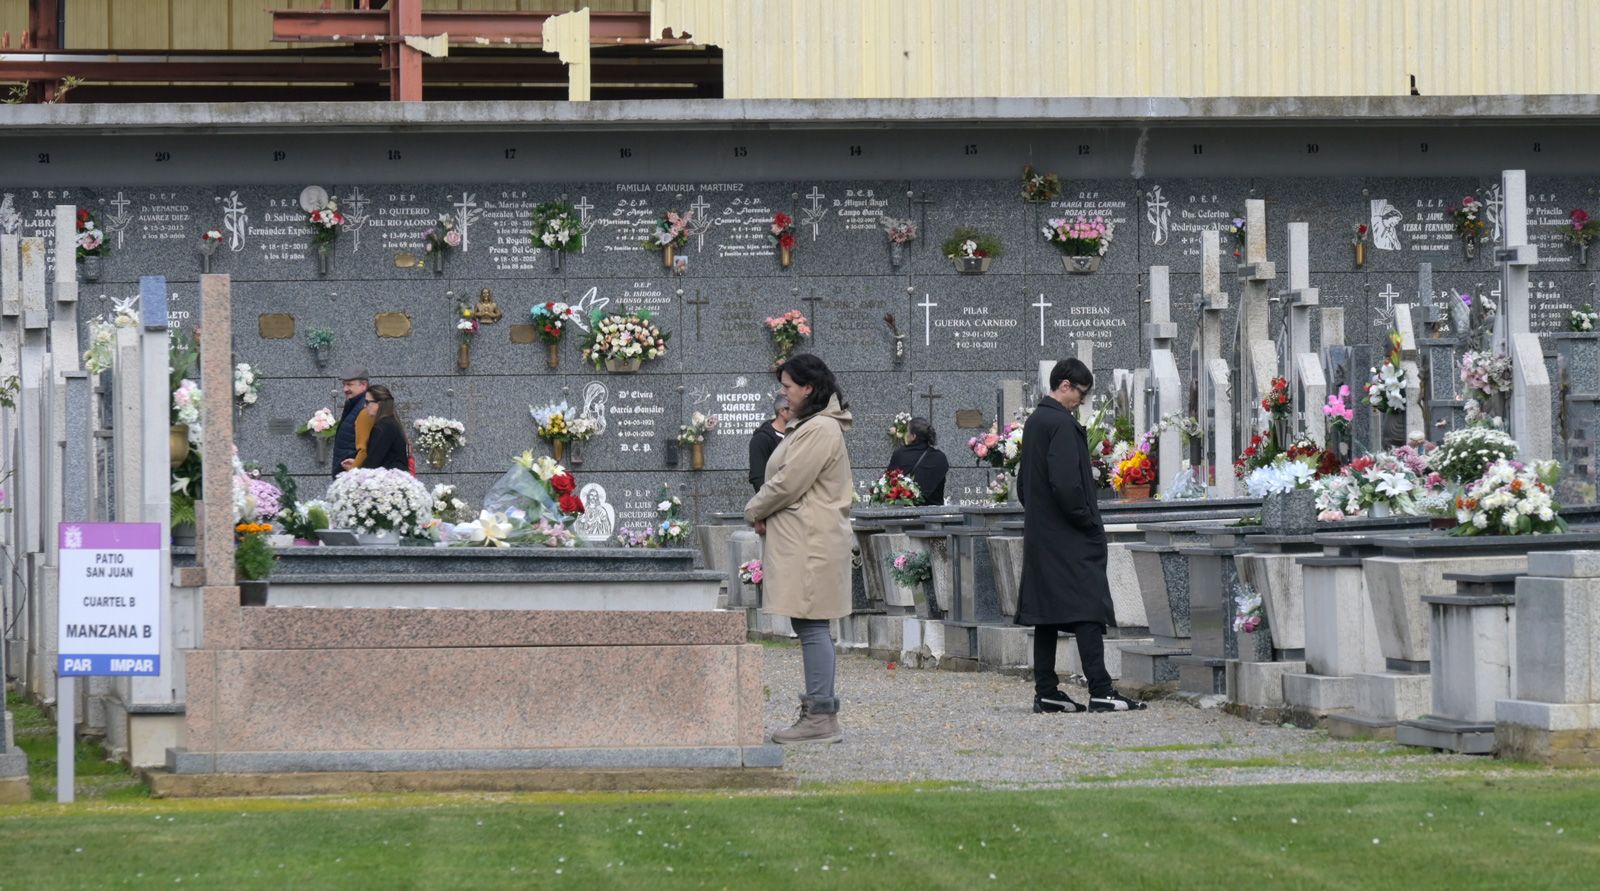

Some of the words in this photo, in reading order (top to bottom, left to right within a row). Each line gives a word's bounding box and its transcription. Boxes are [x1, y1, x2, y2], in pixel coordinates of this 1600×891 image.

[619, 148, 632, 158] 16
[850, 145, 862, 156] 14
[1077, 144, 1090, 155] 12
[1193, 144, 1203, 155] 11
[1306, 143, 1319, 153] 10
[38, 152, 50, 164] 21
[155, 151, 170, 161] 20
[273, 150, 286, 161] 19
[504, 148, 516, 159] 17
[616, 184, 651, 192] FAMILIA
[700, 183, 744, 191] MARTINEZ
[389, 207, 430, 216] QUITERIO
[1425, 212, 1444, 221] JAIME
[273, 212, 306, 222] Salvador
[369, 219, 386, 227] DEL
[403, 219, 437, 227] ALONSO
[1402, 223, 1422, 231] YEBRA
[963, 307, 989, 315] PILAR
[1070, 307, 1110, 315] ESTEBAN
[935, 319, 971, 327] GUERRA
[975, 319, 1017, 327] CARNERO
[1054, 319, 1092, 327] MELGAR
[1093, 319, 1127, 327] GARCIA
[716, 393, 761, 402] NICEFORO
[722, 403, 756, 411] SUAREZ
[96, 553, 124, 564] PATIO
[86, 567, 105, 578] SAN
[107, 567, 134, 578] JUAN
[83, 596, 126, 607] CUARTEL
[129, 597, 136, 607] B
[66, 624, 138, 638] MANZANA
[143, 624, 152, 638] B
[64, 658, 92, 672] PAR
[110, 658, 153, 672] IMPAR
